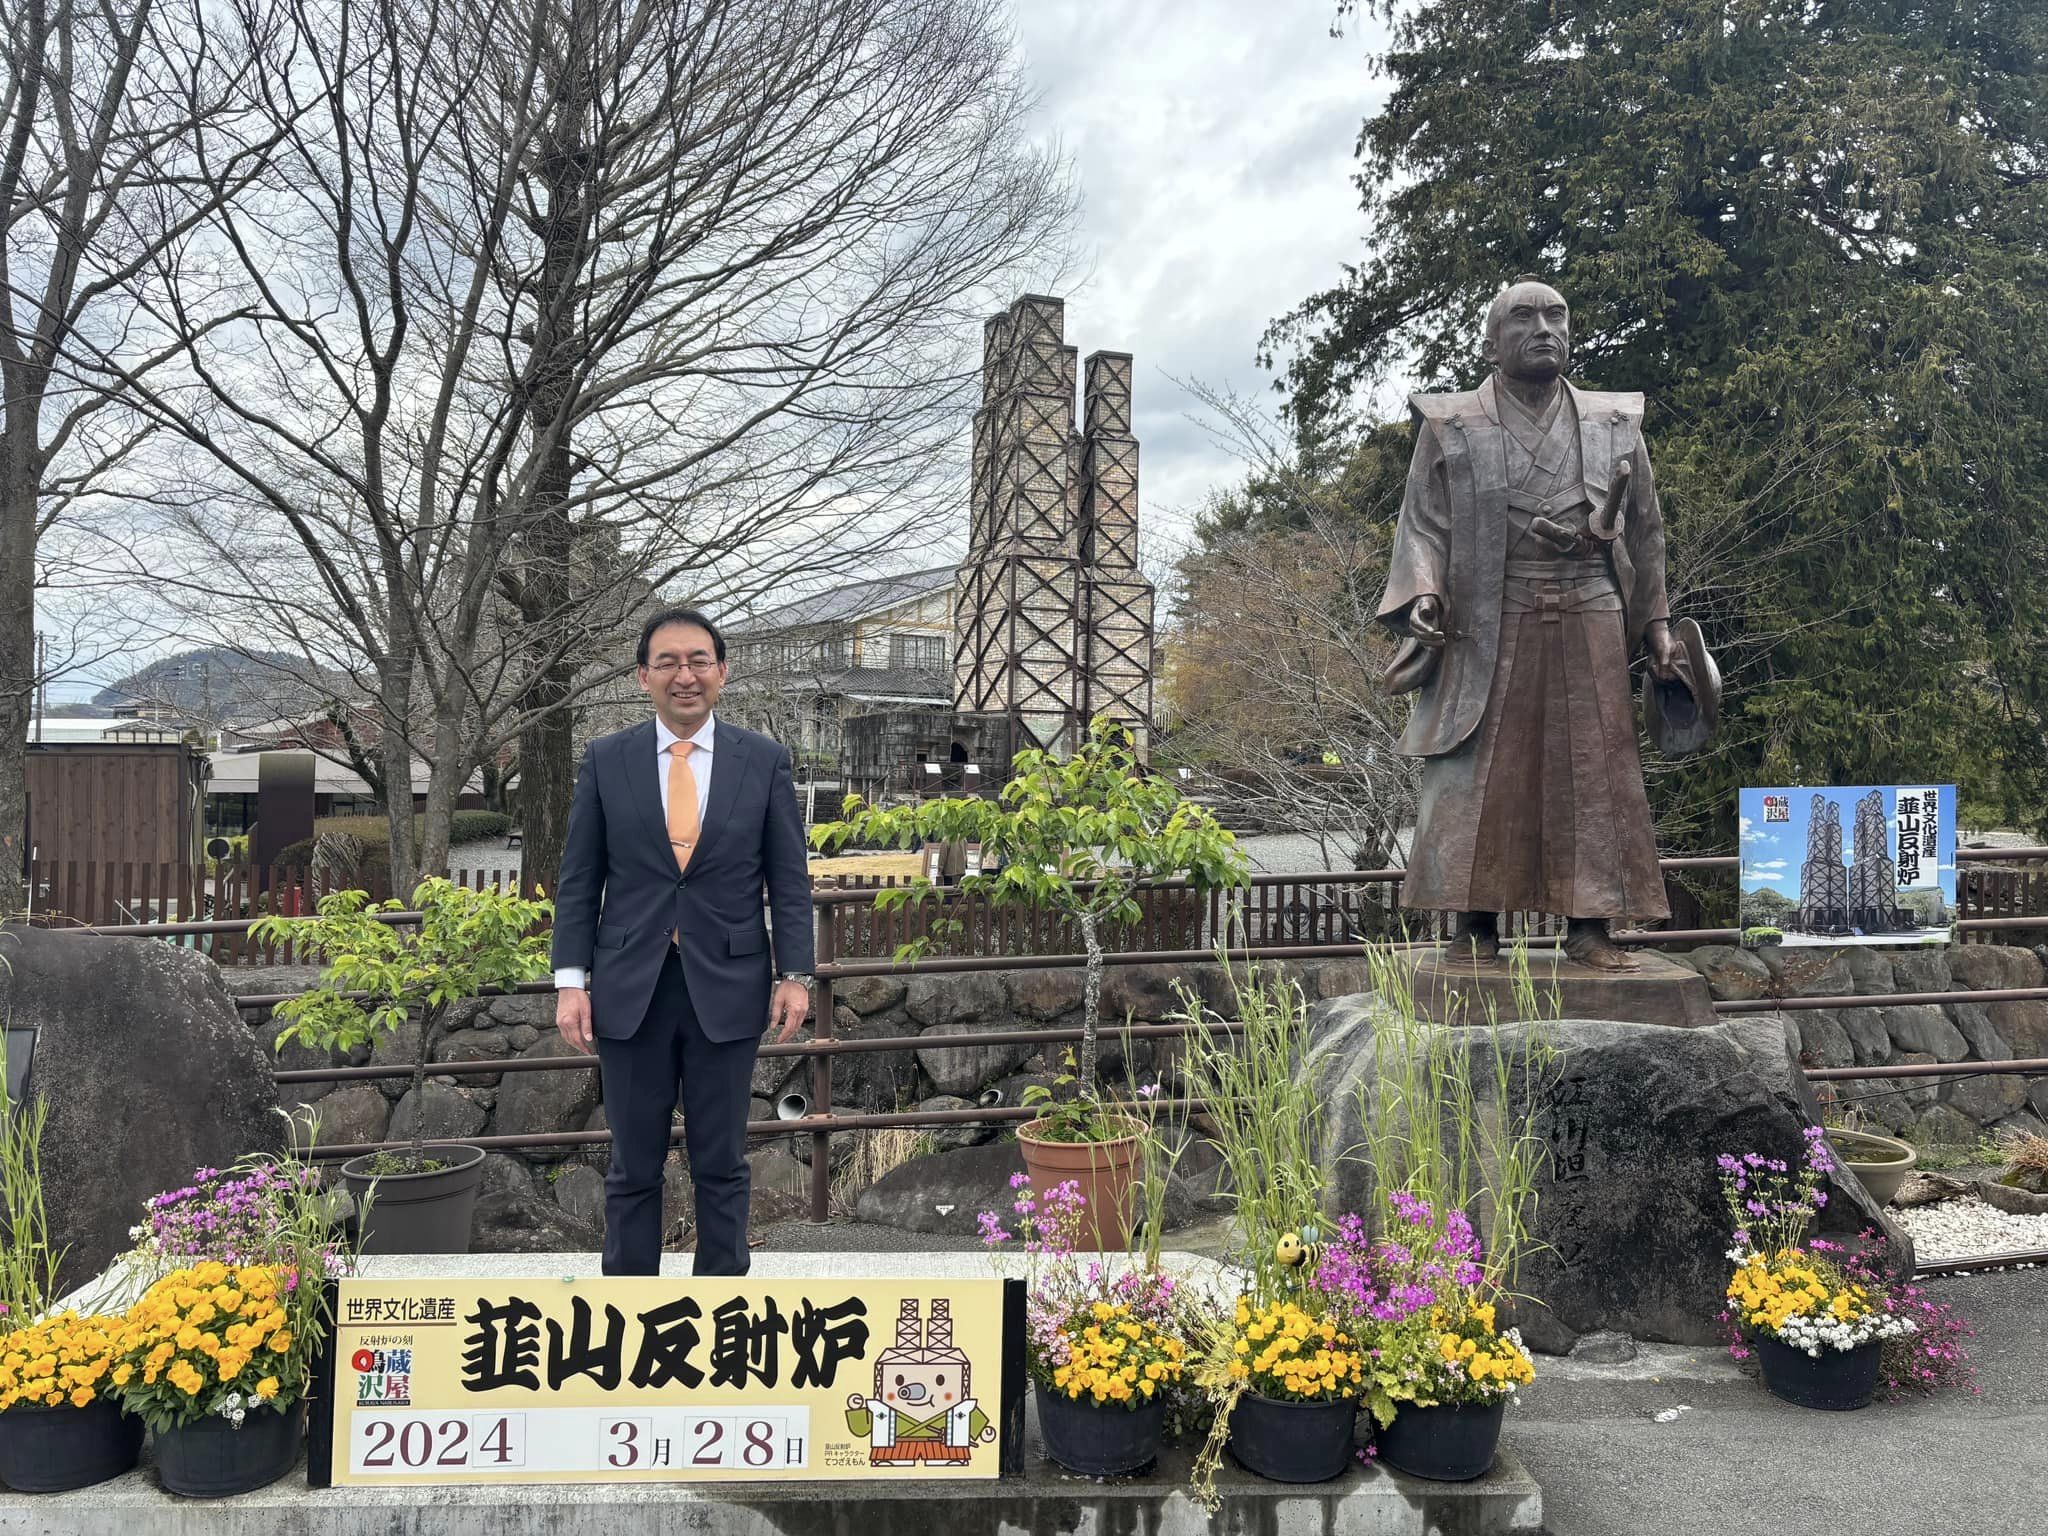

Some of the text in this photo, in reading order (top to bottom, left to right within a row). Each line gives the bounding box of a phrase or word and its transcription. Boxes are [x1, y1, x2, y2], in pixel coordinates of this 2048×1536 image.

[1897, 796, 1920, 886] 韮山反射炉
[1921, 789, 1938, 858] 世界文化遺産
[346, 1297, 456, 1322] 世界文化遺産
[359, 1334, 414, 1346] 反射炉の刻
[461, 1295, 869, 1392] 韮山反射炉
[363, 1418, 513, 1467] 2024
[824, 1457, 866, 1466] てつざえもん
